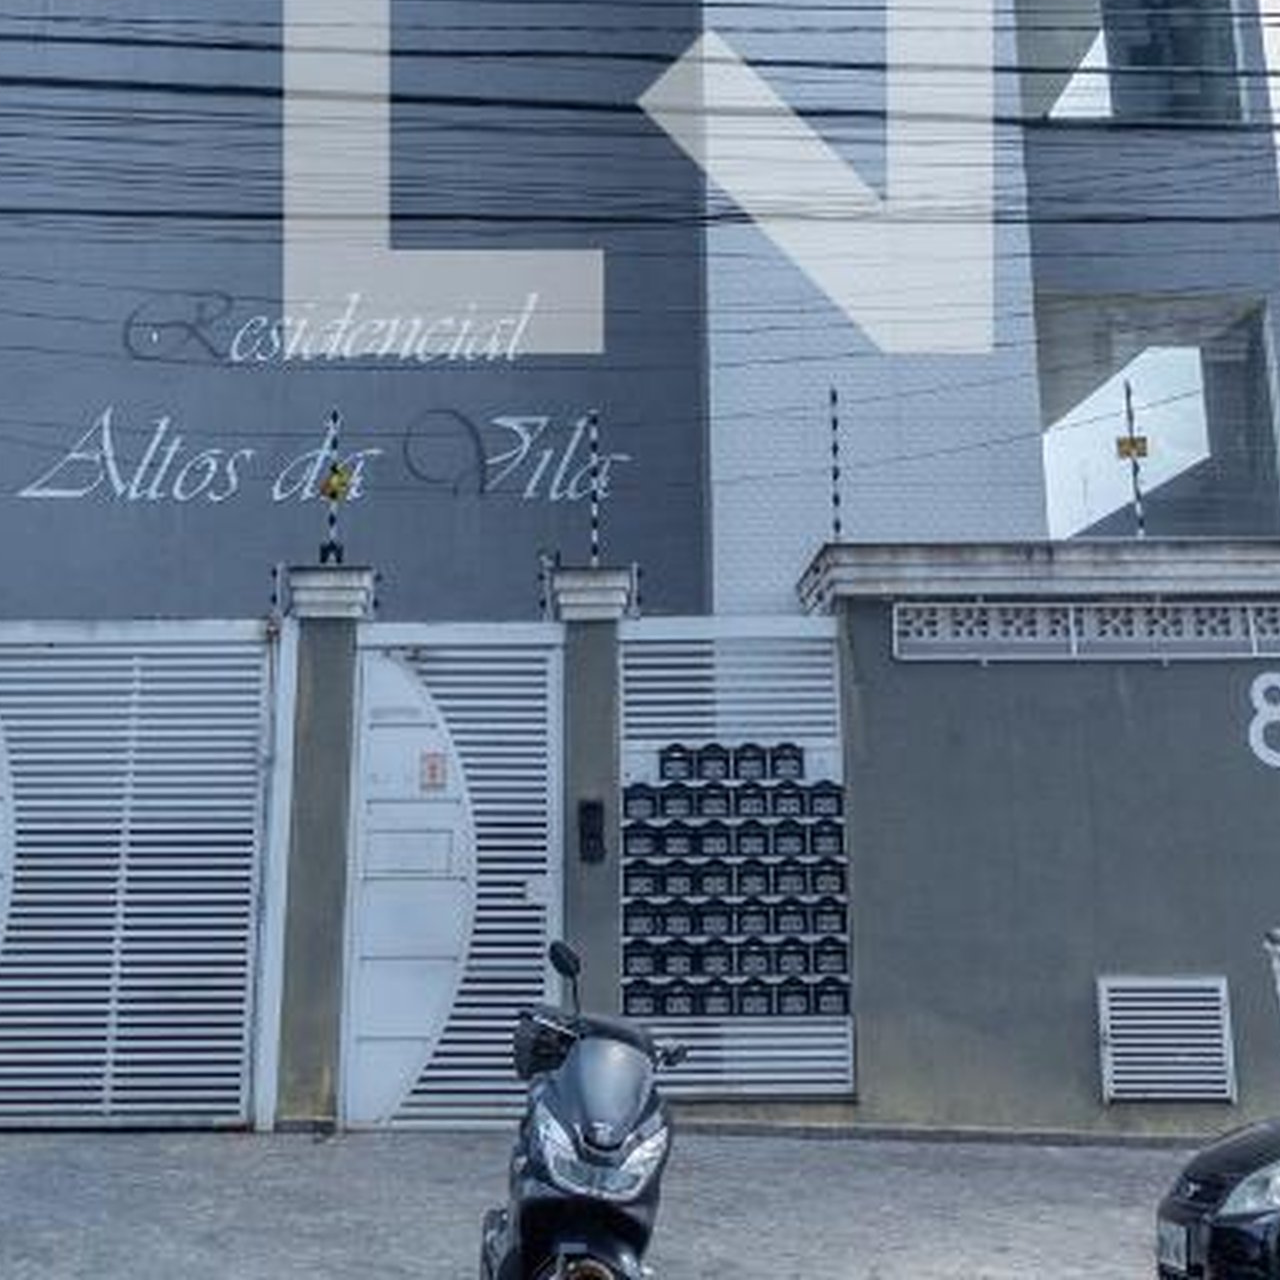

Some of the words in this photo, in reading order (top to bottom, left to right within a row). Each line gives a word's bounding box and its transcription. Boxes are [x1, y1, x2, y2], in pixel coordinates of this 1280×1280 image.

[123, 290, 539, 363] Residencial
[19, 405, 254, 502] Altos
[403, 408, 632, 502] Vila
